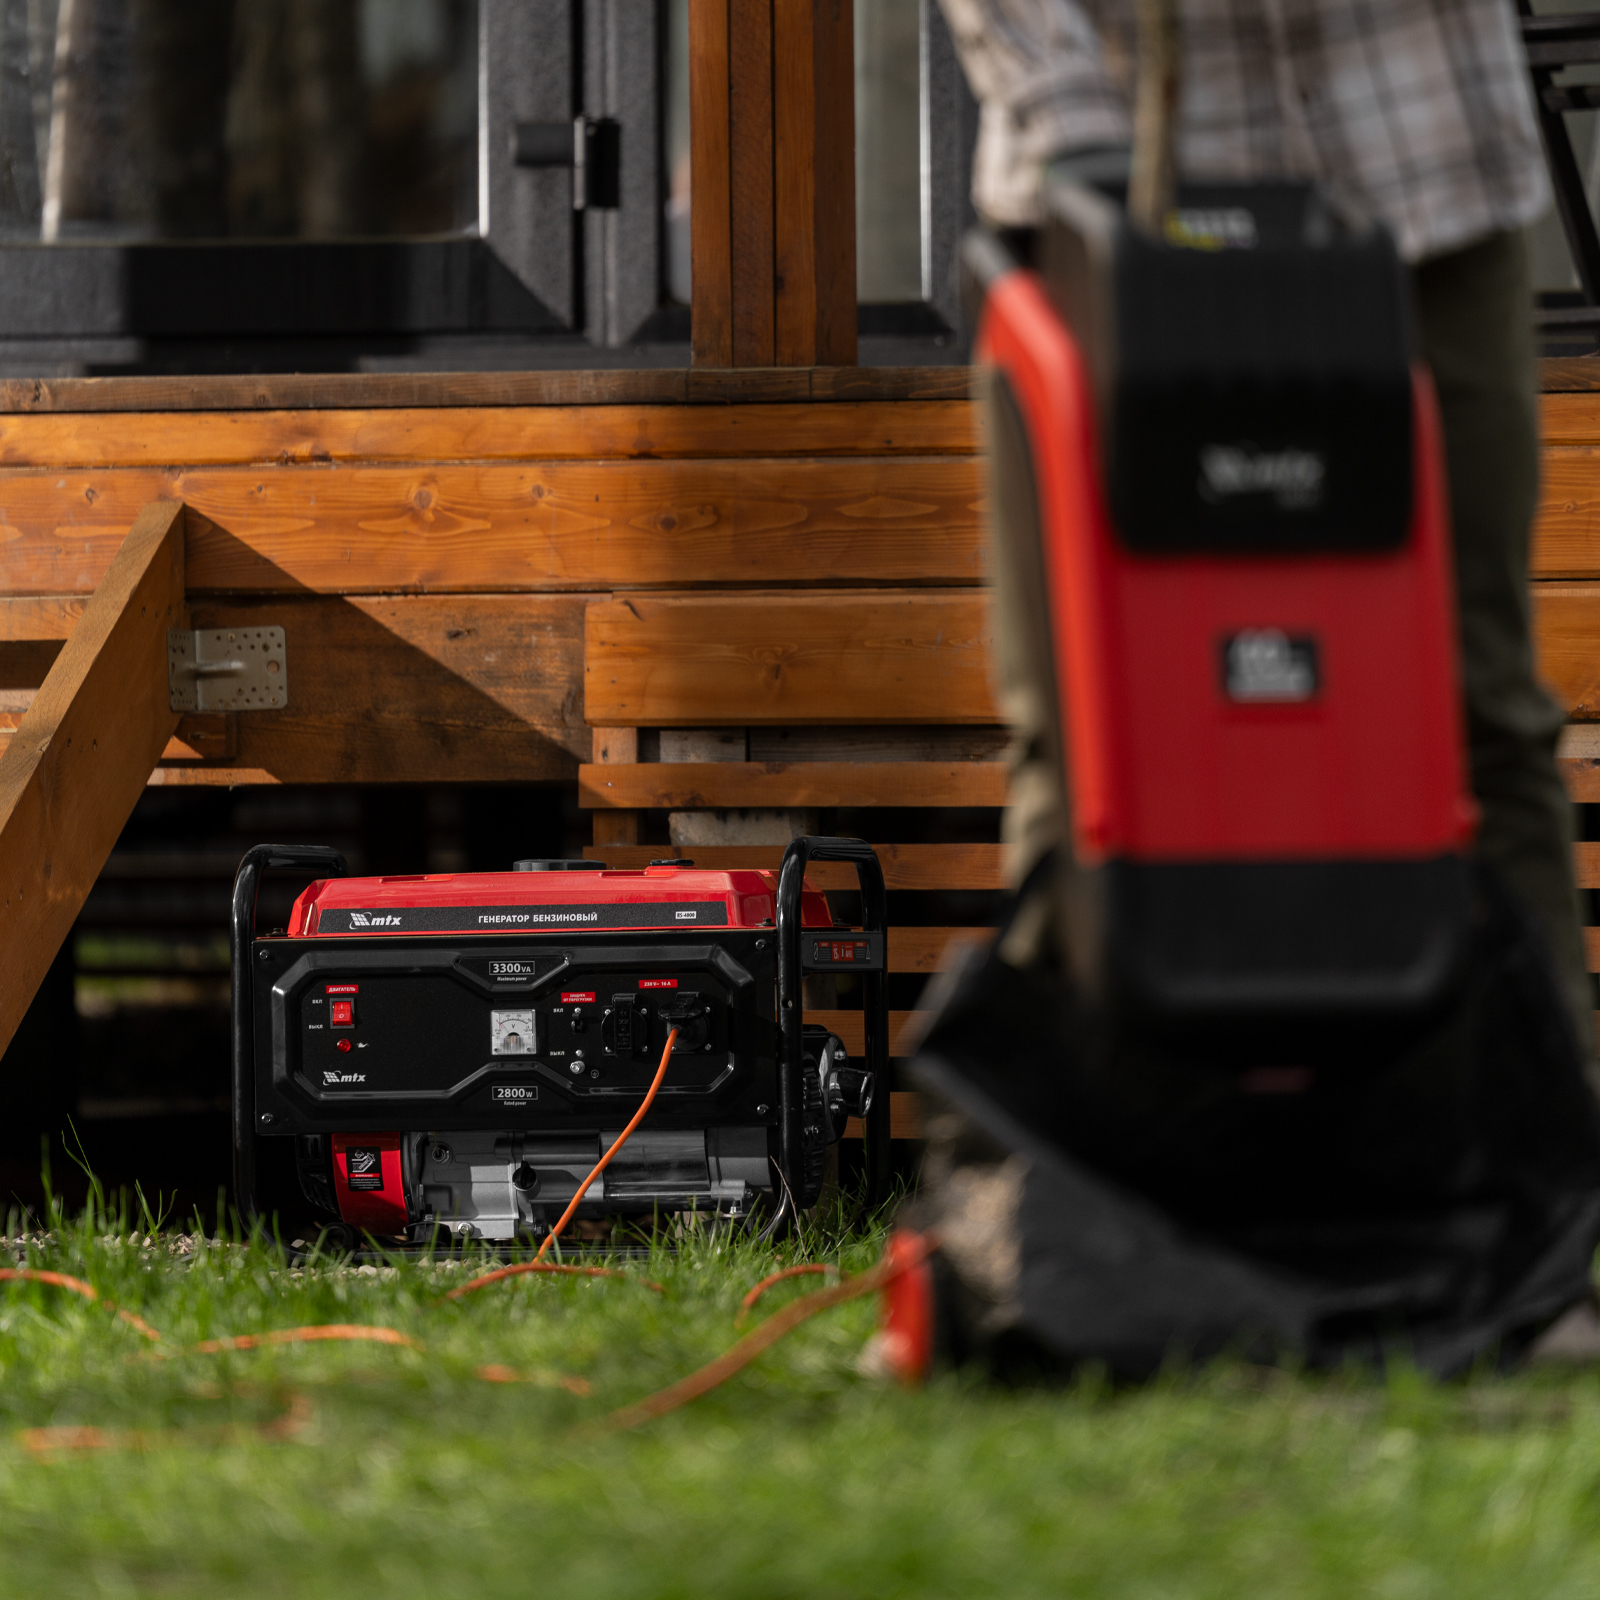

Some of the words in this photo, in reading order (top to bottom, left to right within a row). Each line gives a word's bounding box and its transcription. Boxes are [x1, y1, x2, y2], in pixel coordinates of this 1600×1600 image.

[371, 915, 402, 926] mtx
[478, 914, 530, 924] ГЕНЕРАТОР
[533, 911, 598, 922] БЕНЗИНОВЫЙ
[340, 1073, 367, 1083] mtx
